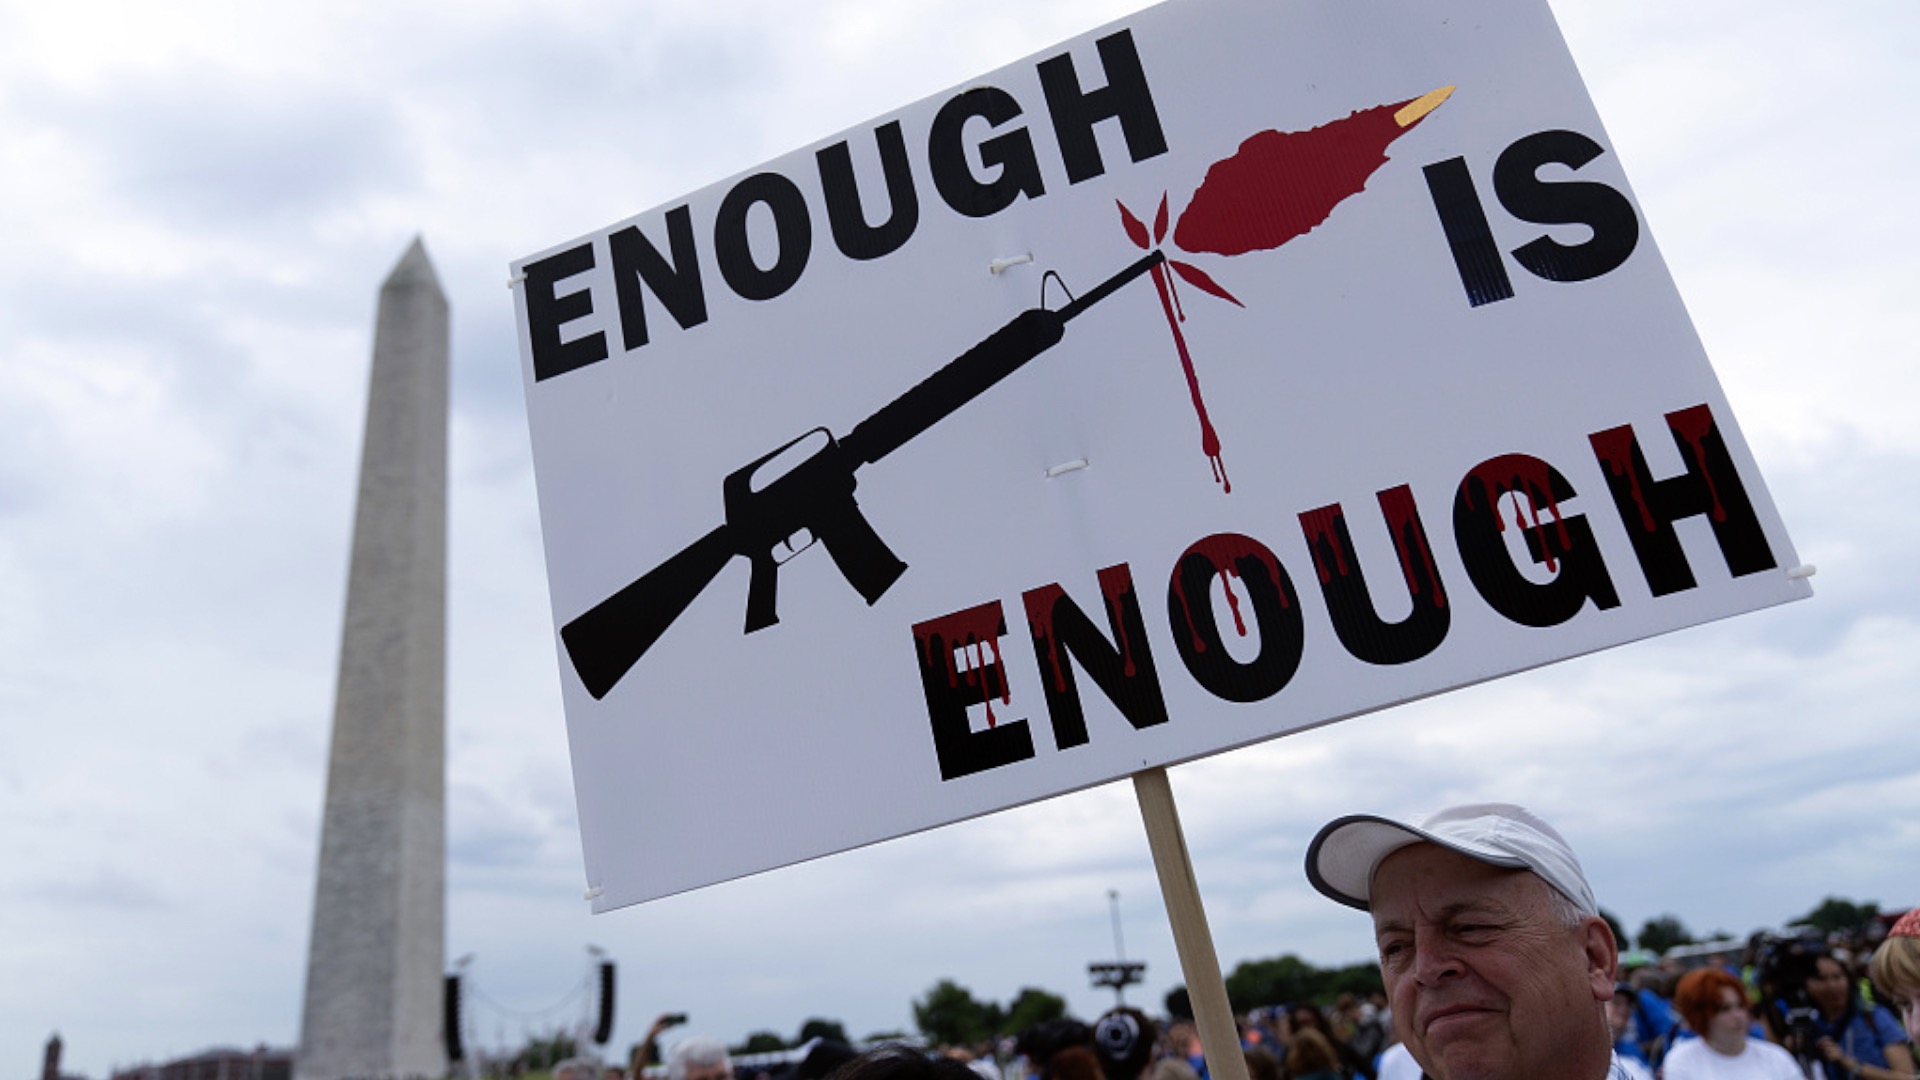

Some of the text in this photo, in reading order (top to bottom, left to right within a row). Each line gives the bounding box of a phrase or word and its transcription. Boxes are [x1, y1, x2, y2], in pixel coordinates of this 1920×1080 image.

[524, 28, 1168, 382] ENOUGH
[1422, 129, 1639, 307] IS
[912, 403, 1777, 781] ENOUGH
